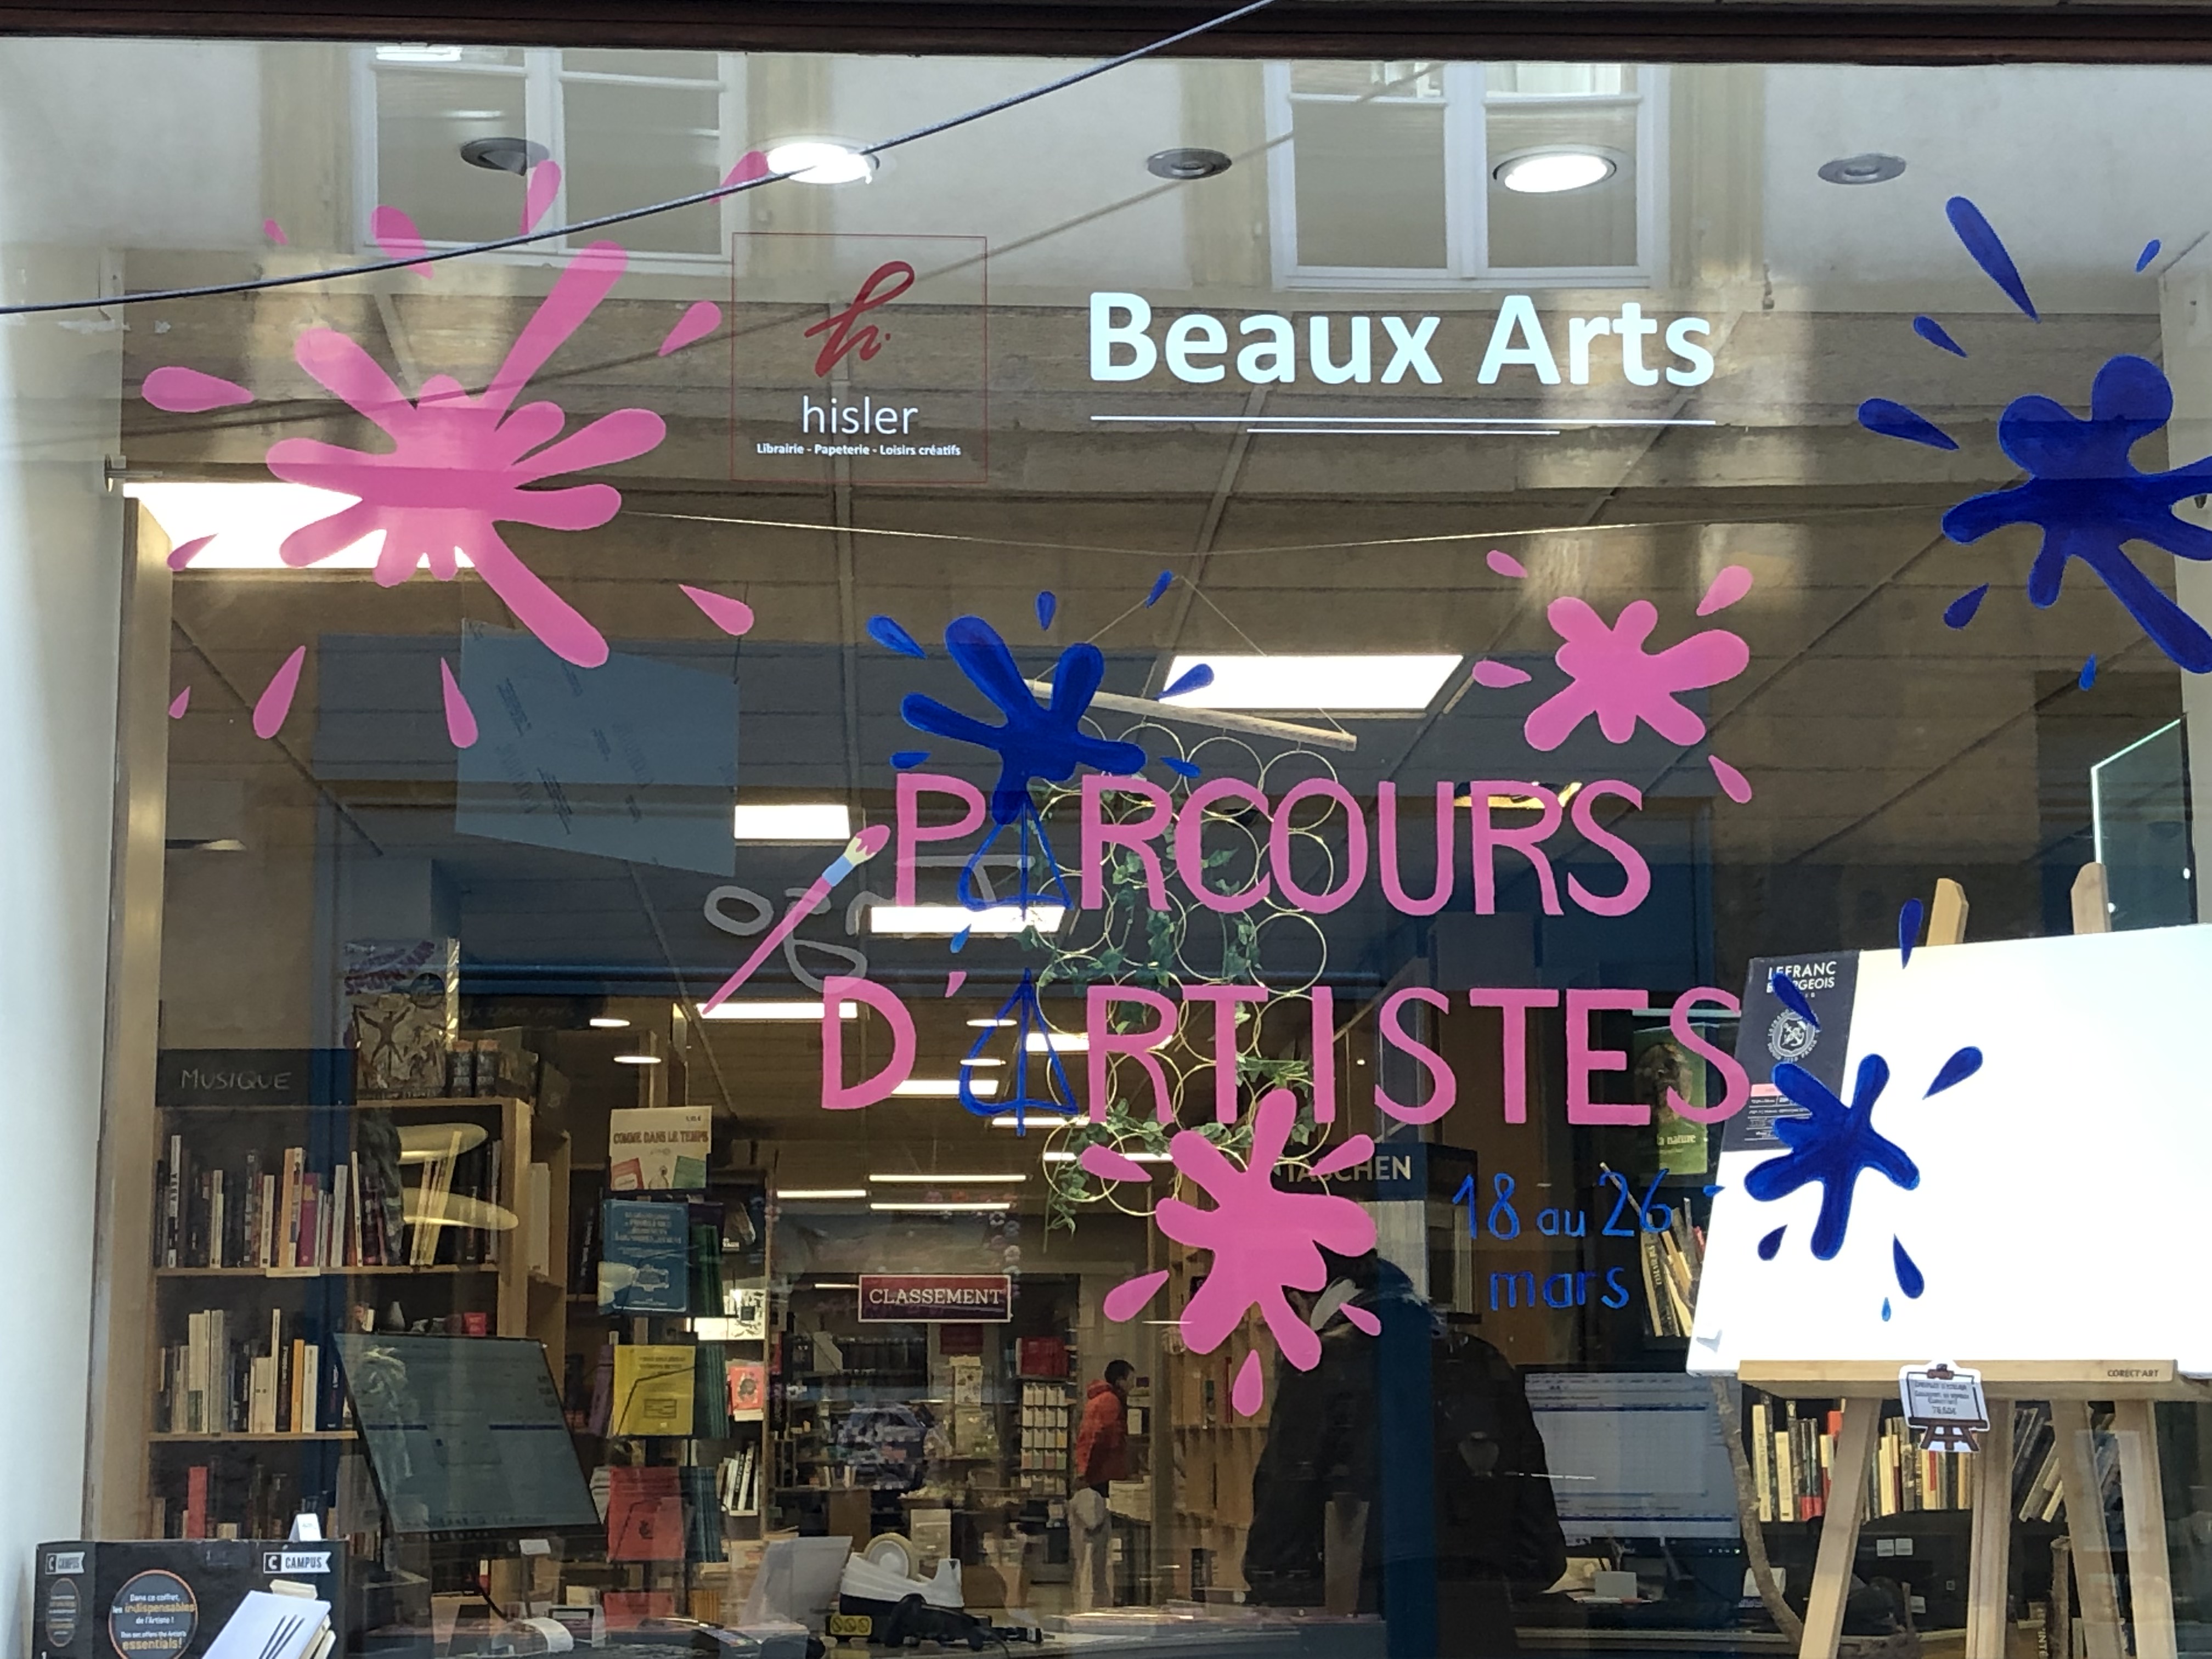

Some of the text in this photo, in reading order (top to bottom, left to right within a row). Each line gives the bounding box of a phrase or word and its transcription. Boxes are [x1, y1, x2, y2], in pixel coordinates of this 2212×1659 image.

[1090, 291, 1716, 387] Beaux Arts
[802, 396, 918, 435] hisler
[757, 443, 805, 455] Librairie
[814, 443, 870, 456] Papeterie
[880, 444, 916, 455] Loisirs
[918, 444, 961, 456] créatifs
[896, 773, 1651, 921] PARCOURS
[821, 968, 1751, 1136] D'ARTISTES
[181, 1069, 292, 1090] MUSIQUE
[680, 1130, 709, 1142] TEMPS
[1452, 1169, 1672, 1240] 18 au 26
[869, 1288, 1002, 1305] CLASSEMENT
[1489, 1266, 1629, 1311] mars
[285, 1556, 323, 1570] CAMPUS
